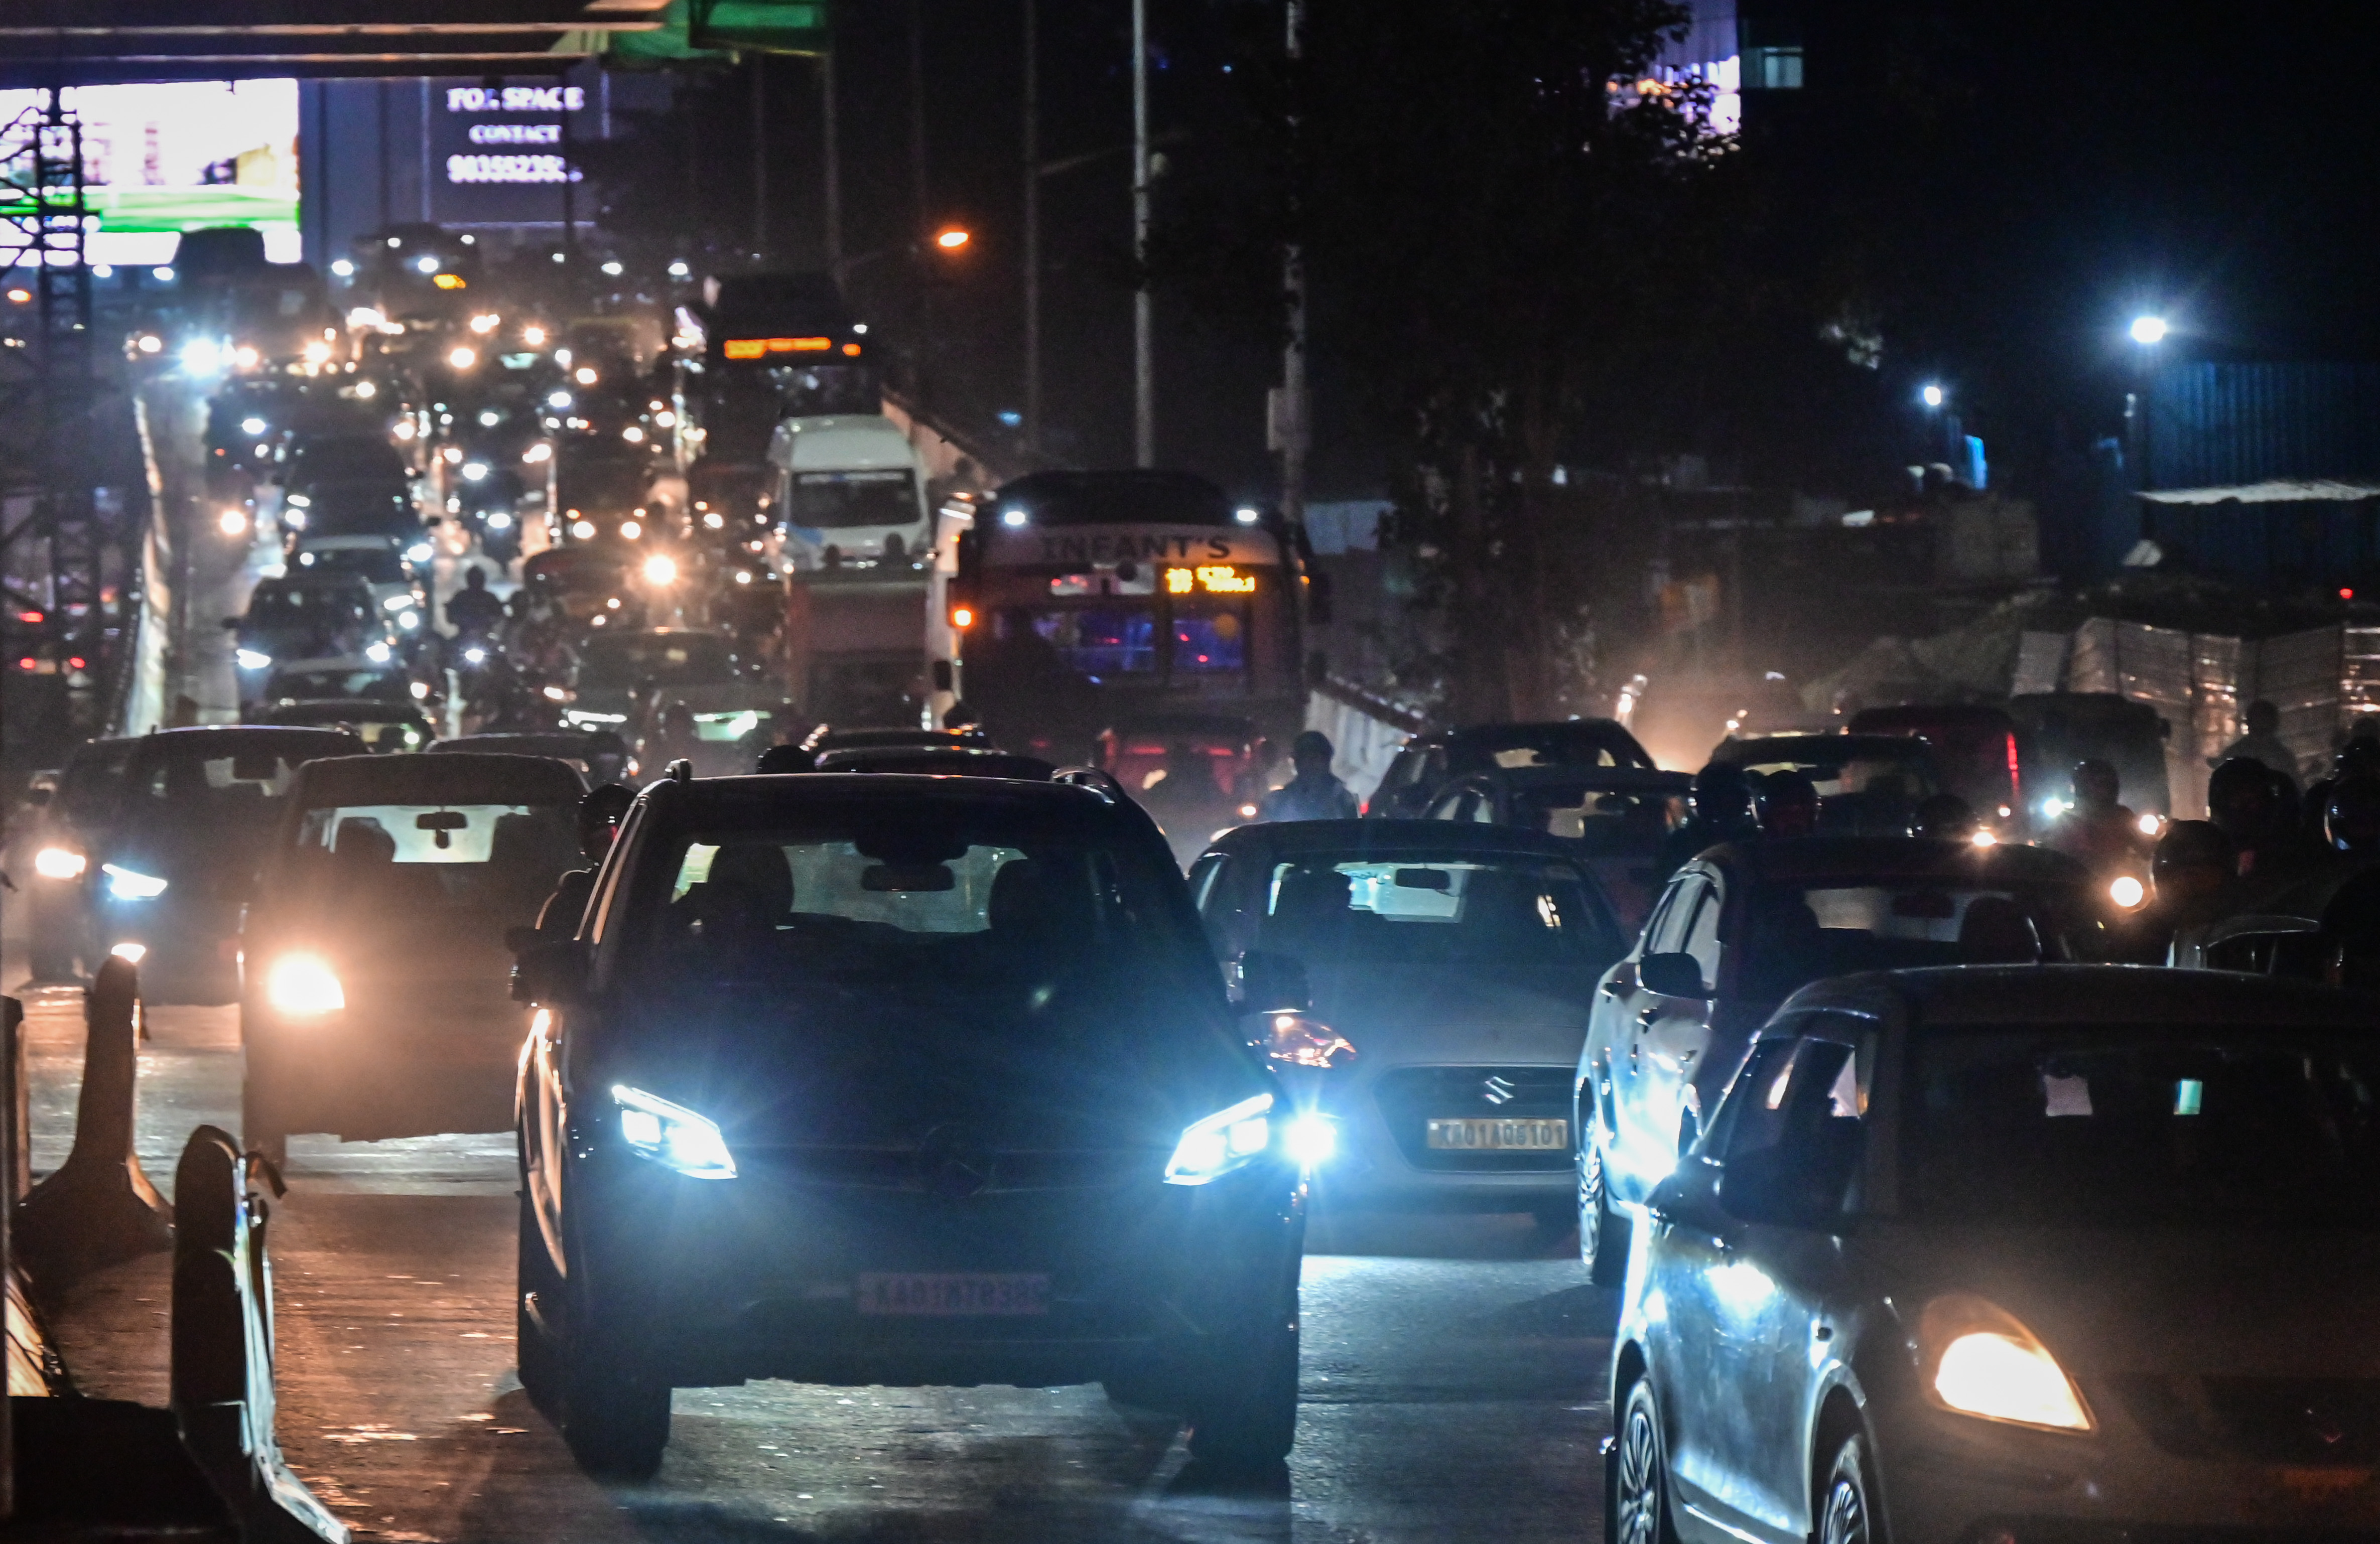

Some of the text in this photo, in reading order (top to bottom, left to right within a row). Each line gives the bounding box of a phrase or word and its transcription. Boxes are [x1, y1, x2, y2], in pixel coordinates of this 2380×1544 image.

[502, 86, 585, 111] SPACE
[469, 124, 562, 144] CONTACT
[1043, 534, 1230, 558] INFANT'S
